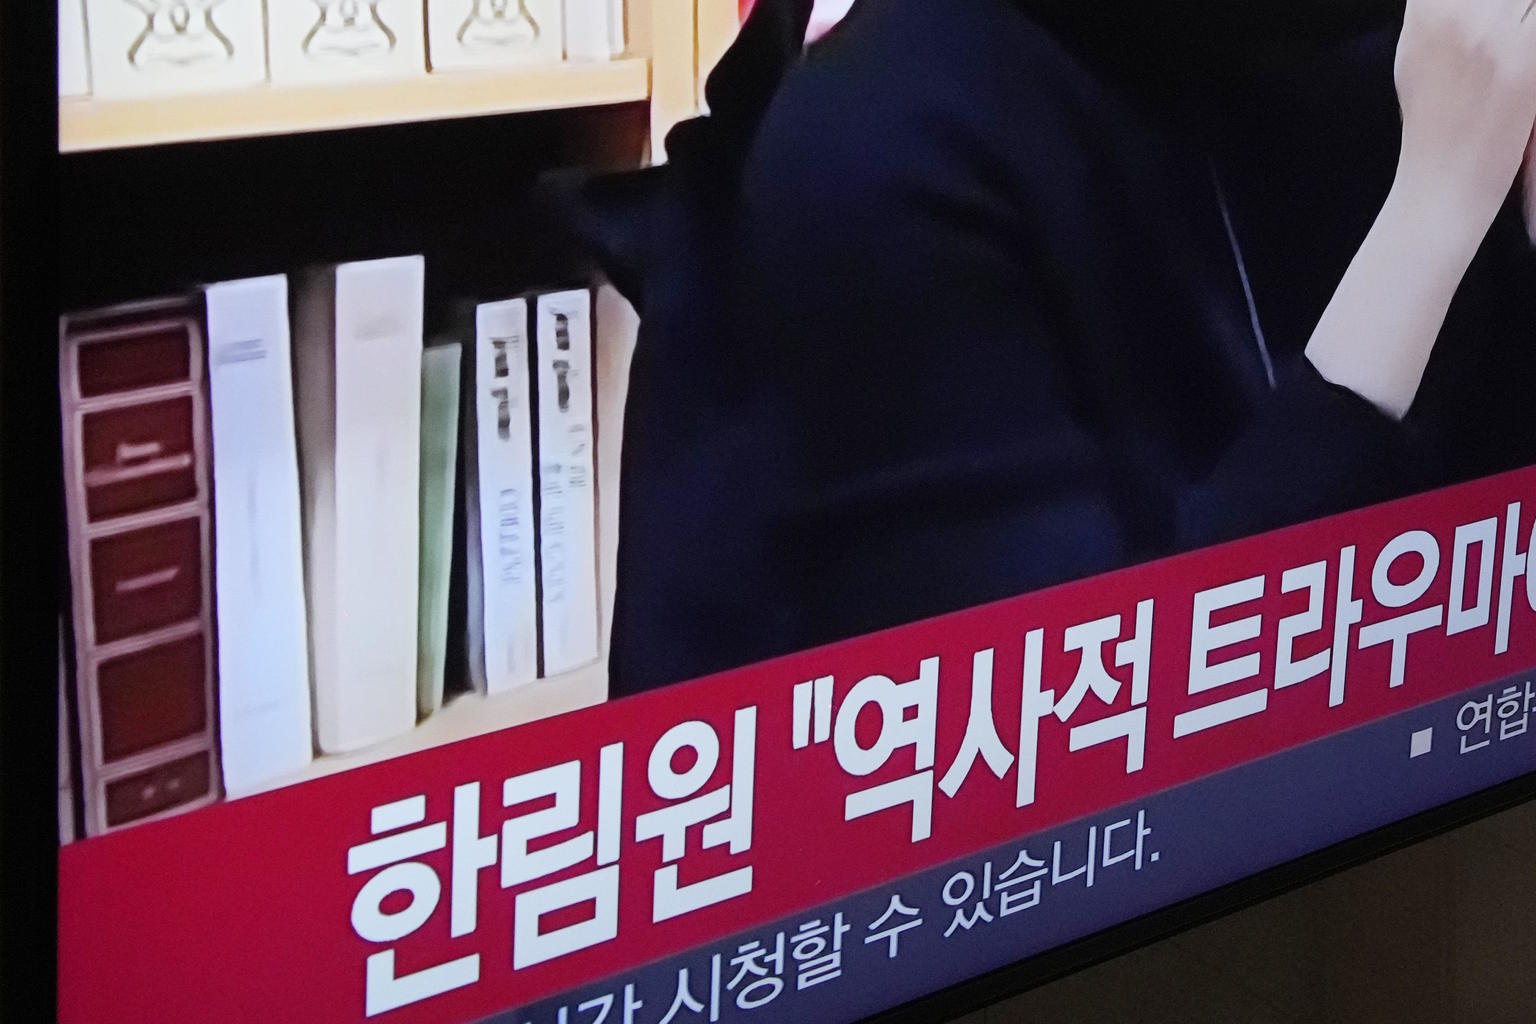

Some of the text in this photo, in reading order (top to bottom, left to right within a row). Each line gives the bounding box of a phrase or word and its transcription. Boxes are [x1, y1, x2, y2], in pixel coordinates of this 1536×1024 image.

[347, 705, 758, 1018] 한림원
[792, 598, 1155, 843] "역사적
[658, 912, 851, 1024] 시청할
[863, 892, 922, 957] 수
[942, 810, 1160, 936] 있습니다.
